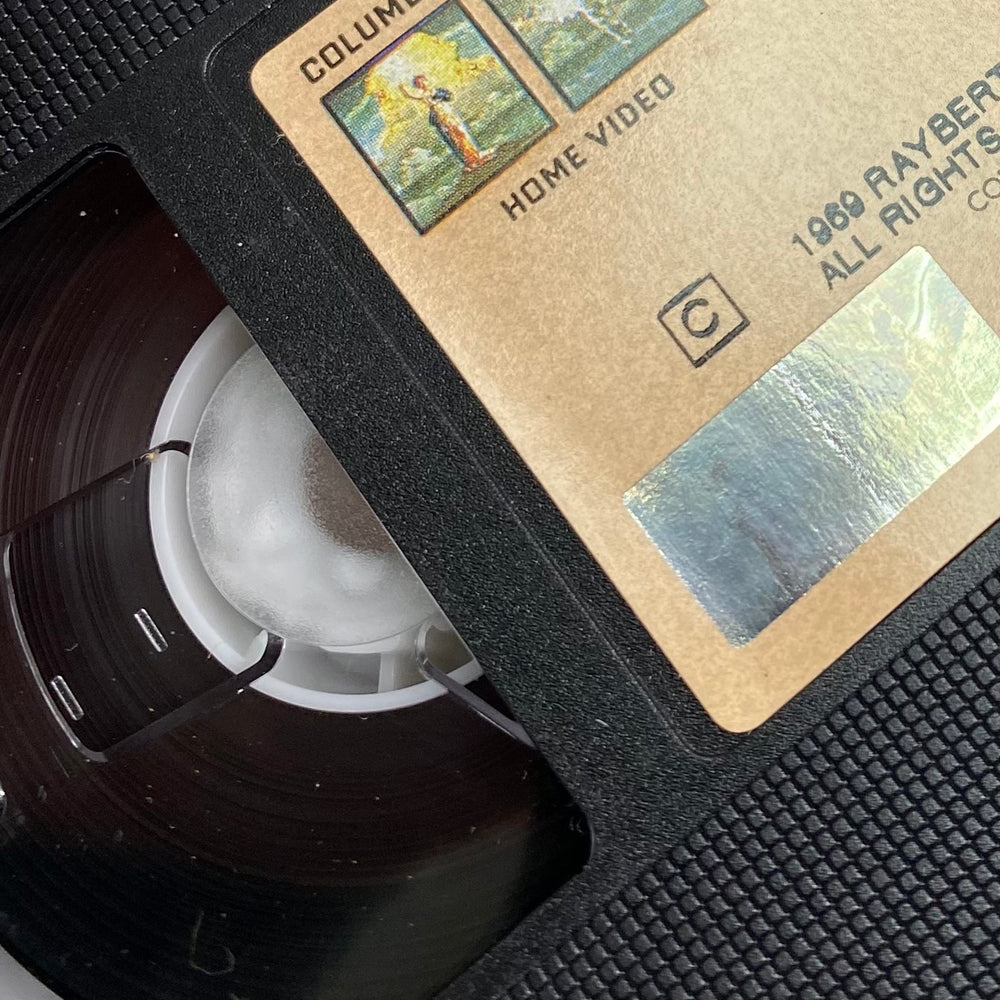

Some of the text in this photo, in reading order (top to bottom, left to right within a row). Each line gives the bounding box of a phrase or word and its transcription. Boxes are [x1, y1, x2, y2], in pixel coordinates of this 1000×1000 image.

[500, 72, 676, 222] HOME VIDEO
[792, 190, 865, 256] 1969
[819, 235, 882, 290] ALL
